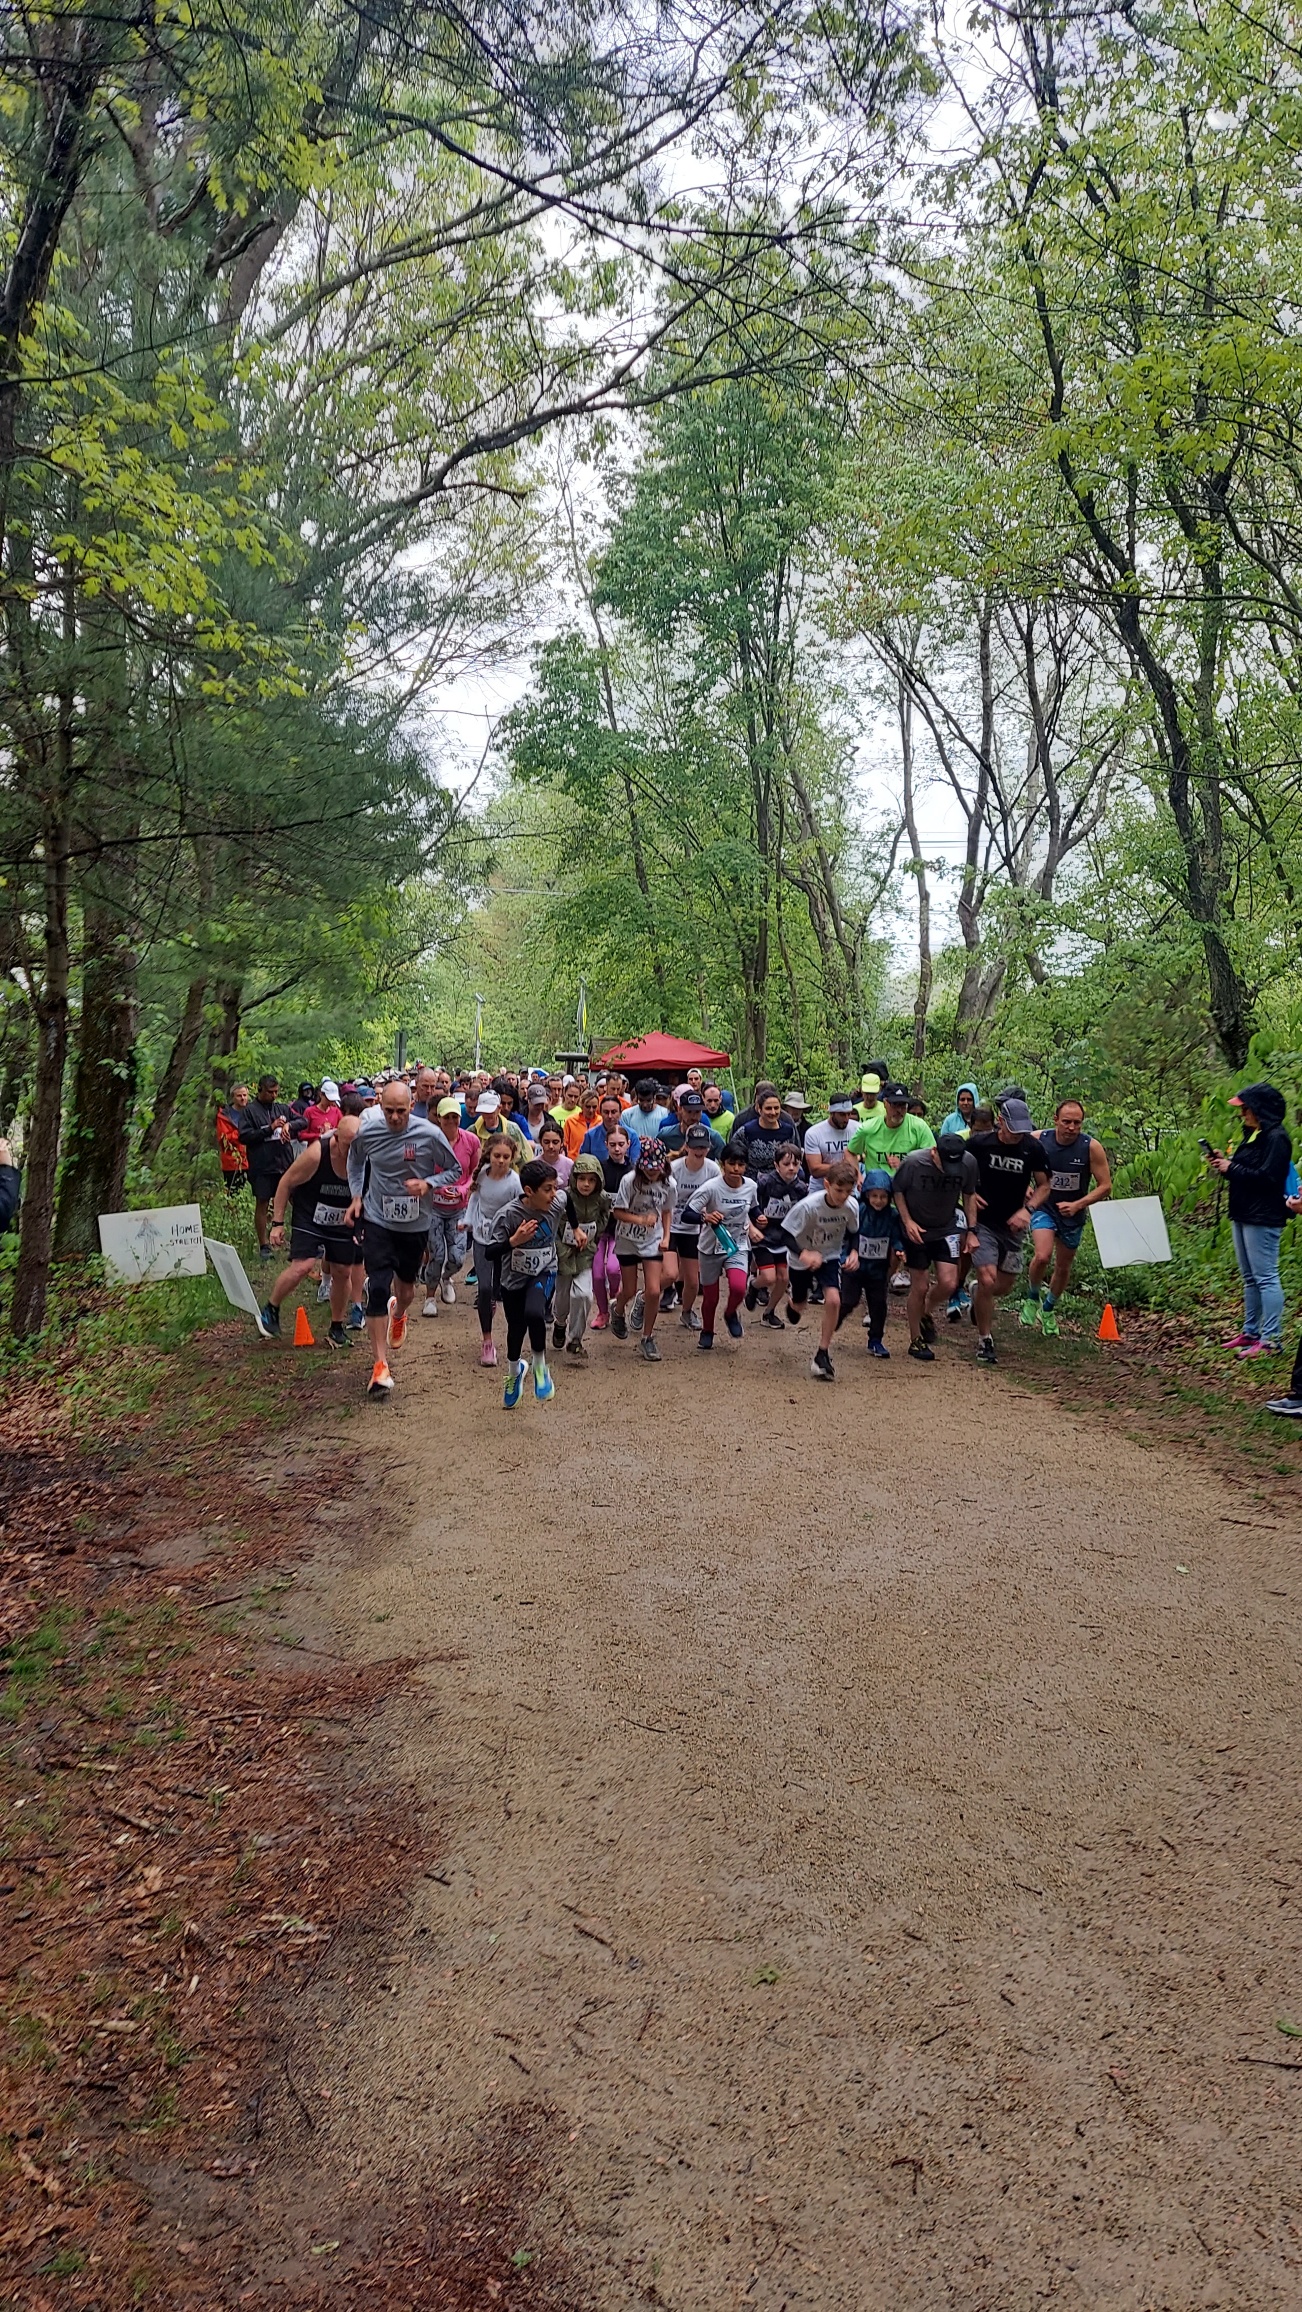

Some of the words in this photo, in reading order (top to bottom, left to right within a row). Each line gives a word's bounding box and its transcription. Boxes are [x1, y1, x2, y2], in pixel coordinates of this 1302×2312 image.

[989, 1153, 1024, 1171] TVFR
[920, 1174, 963, 1189] TVFR
[1054, 1176, 1070, 1187] 212
[394, 1203, 408, 1217] 58
[171, 1224, 200, 1237] HOME
[169, 1236, 202, 1247] STRETCH
[524, 1256, 540, 1269] 59
